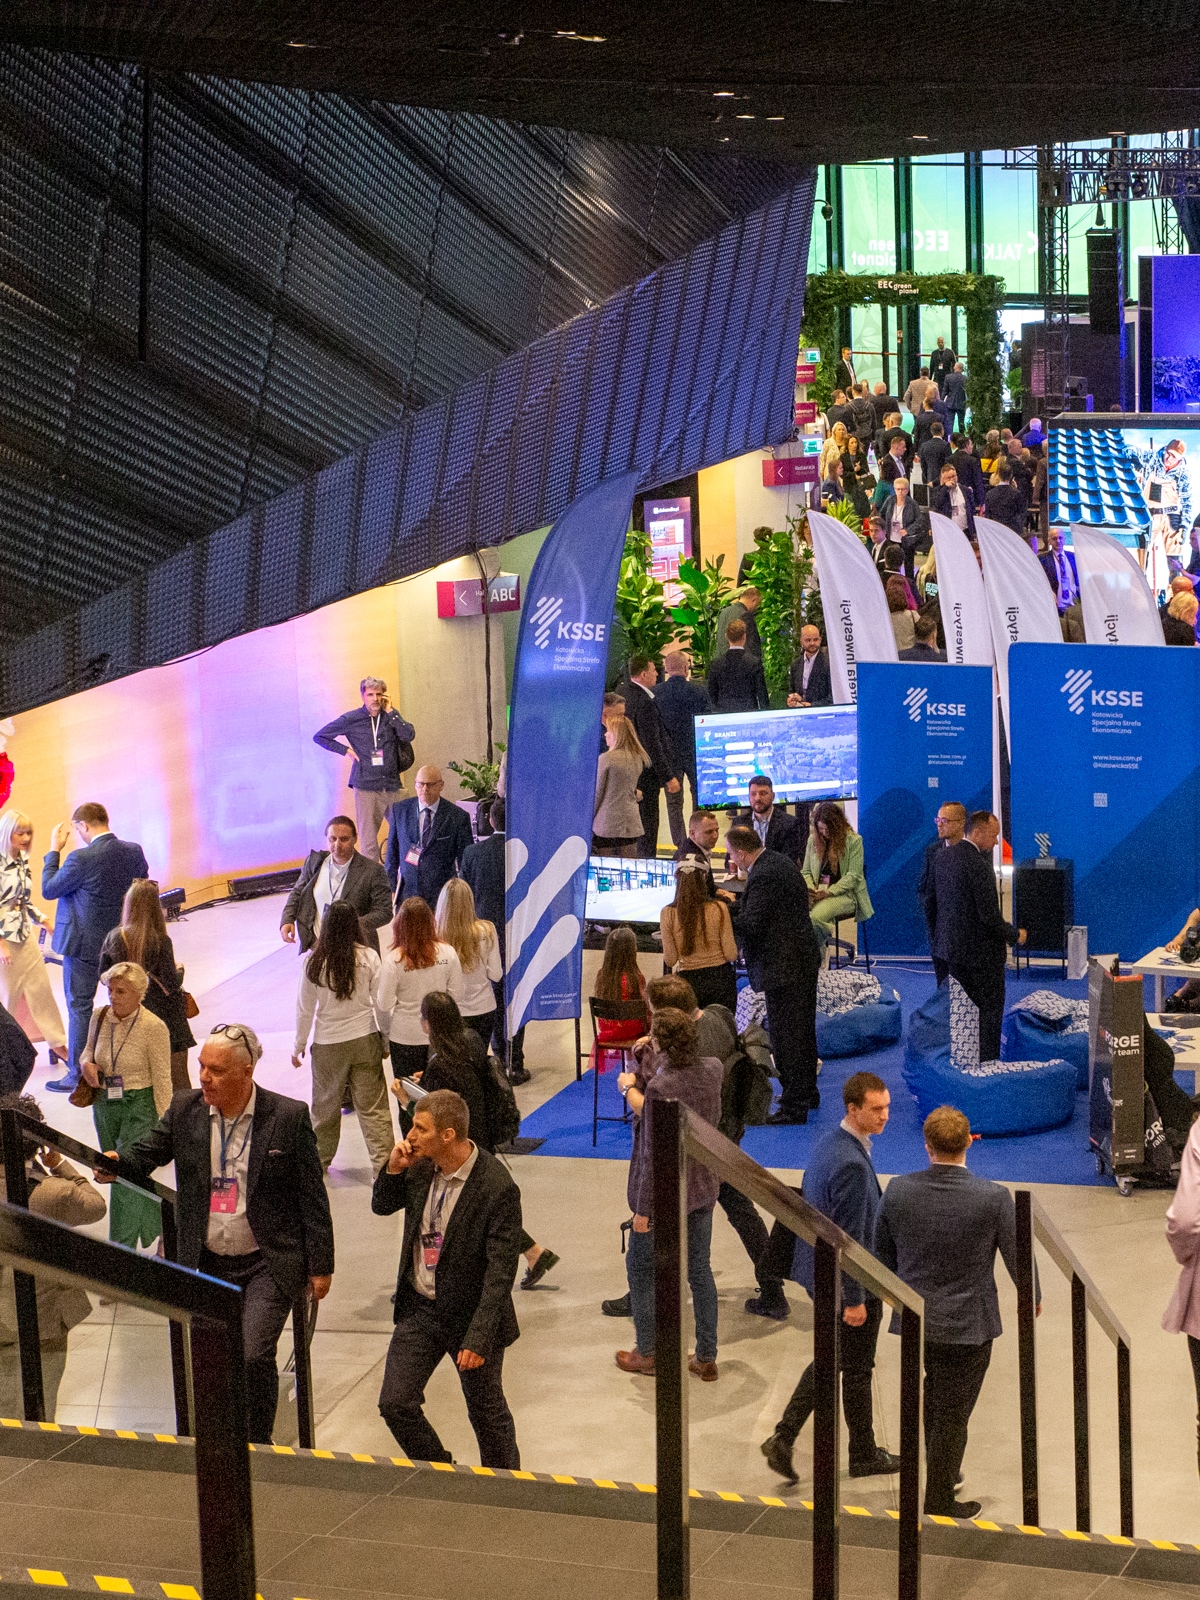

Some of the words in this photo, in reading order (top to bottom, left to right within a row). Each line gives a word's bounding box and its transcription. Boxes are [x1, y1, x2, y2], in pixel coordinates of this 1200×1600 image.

[877, 280, 893, 289] EEC
[893, 283, 912, 291] green
[898, 288, 920, 296] planet
[490, 587, 516, 603] ABC
[557, 621, 606, 642] KSSE
[1091, 689, 1144, 707] KSSE
[926, 703, 967, 717] KSSE
[1091, 711, 1124, 719] Katowicka
[1091, 719, 1121, 727] Specjalna
[1122, 719, 1142, 727] Strefa
[1091, 727, 1132, 735] Ekonomiczna
[1092, 755, 1143, 763] www.ksse.com.pl
[1092, 762, 1139, 770] @KatowickaSSE
[1117, 1048, 1140, 1057] team
